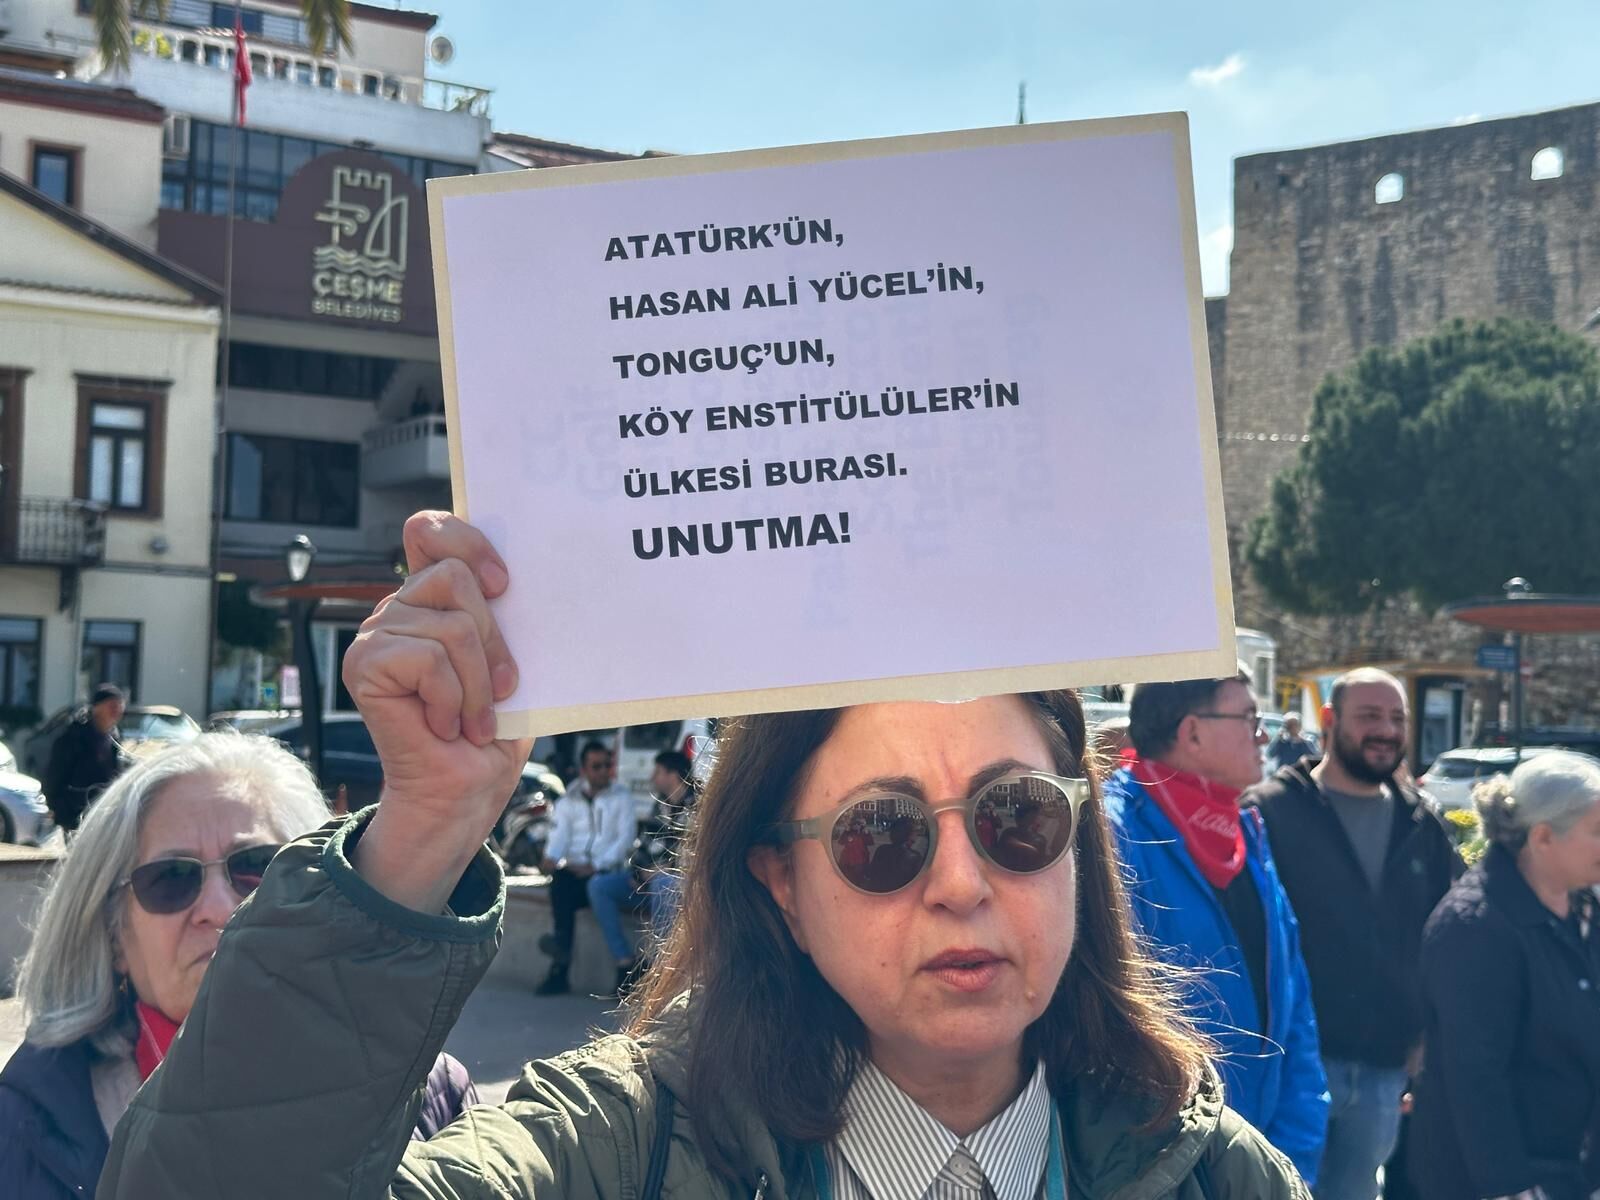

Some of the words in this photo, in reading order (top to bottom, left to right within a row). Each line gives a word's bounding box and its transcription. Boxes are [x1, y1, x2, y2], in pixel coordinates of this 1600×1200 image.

[605, 217, 843, 263] ATATÜRK’ÜN,
[312, 271, 403, 304] ÇEŞME
[610, 288, 730, 320] HASAN
[743, 276, 798, 309] ALİ
[809, 263, 984, 302] YÜCEL’İN,
[613, 339, 835, 378] TONGUÇ’UN,
[619, 407, 693, 438] KÖY
[706, 378, 1019, 431] ENSTİTÜLÜLER’İN
[624, 459, 751, 498] ÜLKESİ
[765, 453, 908, 486] BURASI.
[632, 512, 850, 559] UNUTMA!
